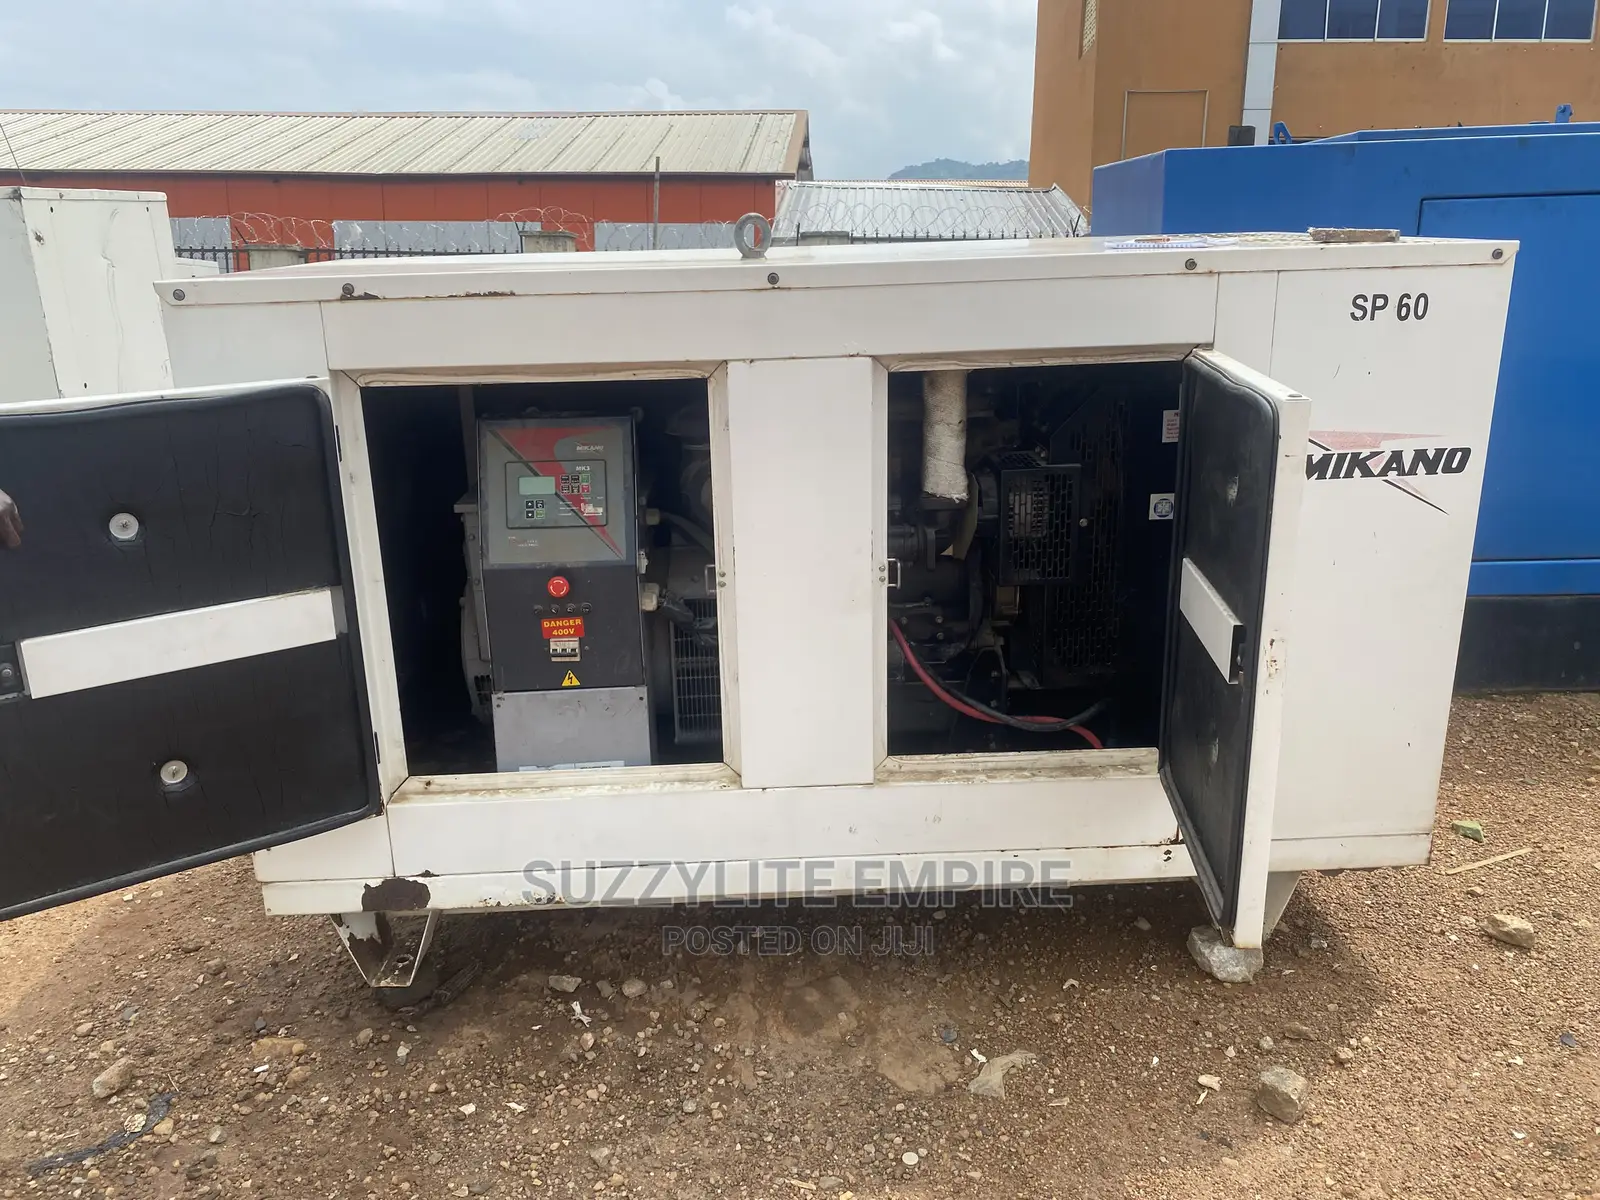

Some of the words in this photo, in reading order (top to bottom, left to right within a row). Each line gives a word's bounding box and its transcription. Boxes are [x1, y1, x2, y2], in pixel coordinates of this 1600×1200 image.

[1350, 293, 1389, 322] SP
[1396, 292, 1429, 322] 60
[543, 618, 582, 628] DANGER
[552, 628, 575, 636] 400V
